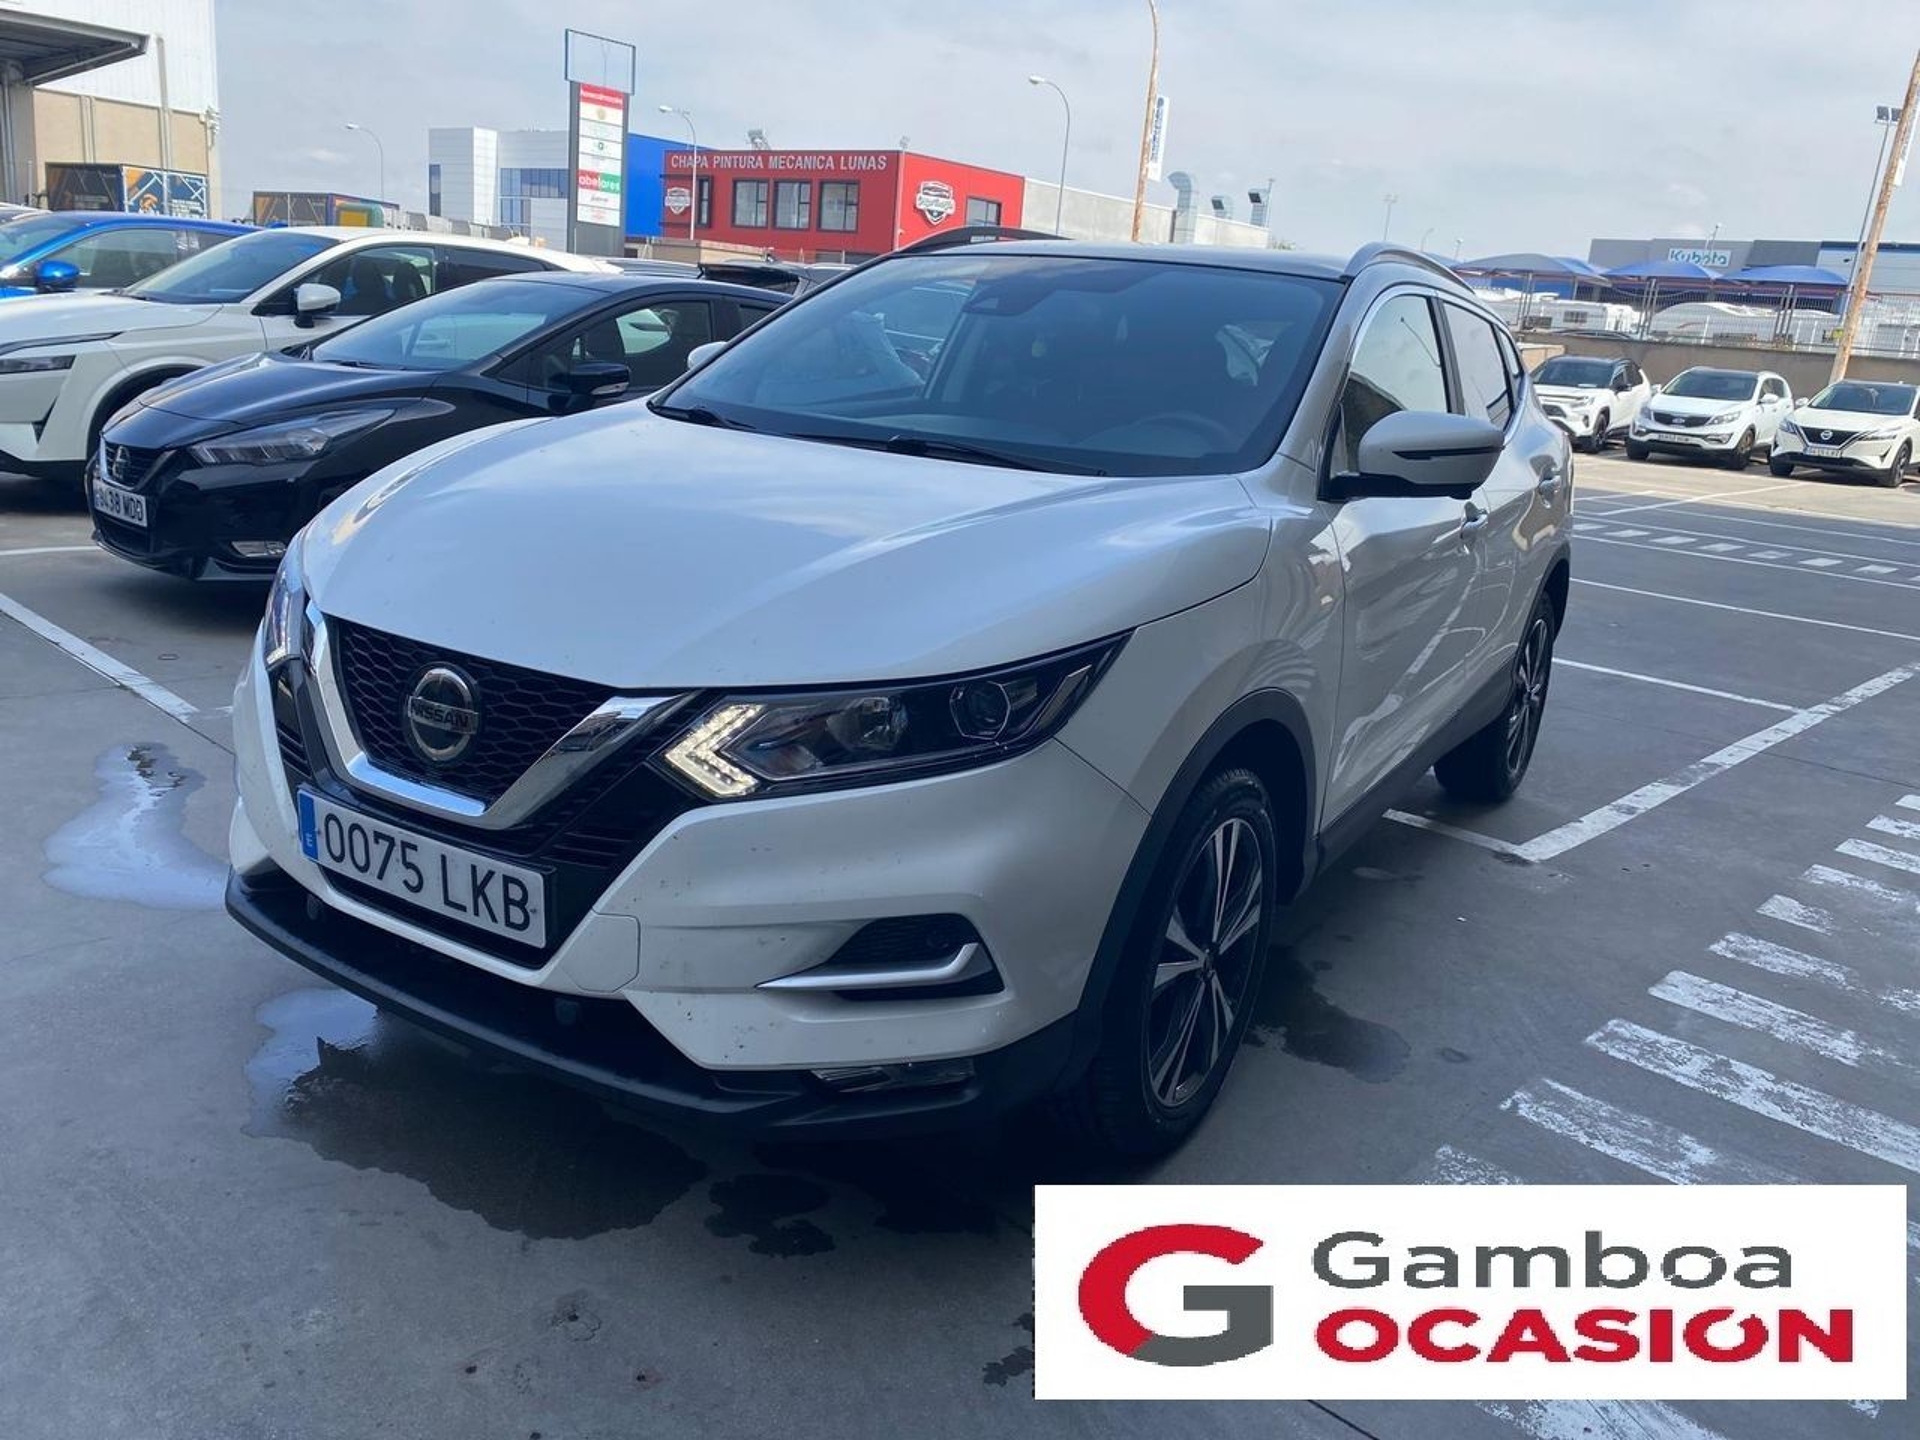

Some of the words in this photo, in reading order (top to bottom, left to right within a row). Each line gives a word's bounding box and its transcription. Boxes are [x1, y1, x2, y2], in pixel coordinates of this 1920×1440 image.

[671, 155, 708, 168] CHAPA
[713, 156, 764, 169] PINTURA
[768, 156, 835, 171] MECANICA
[840, 155, 888, 170] LUNAS
[1671, 250, 1727, 265] Kubota
[411, 699, 469, 729] NISSAN
[324, 813, 424, 893] 0075
[440, 854, 530, 932] LKB
